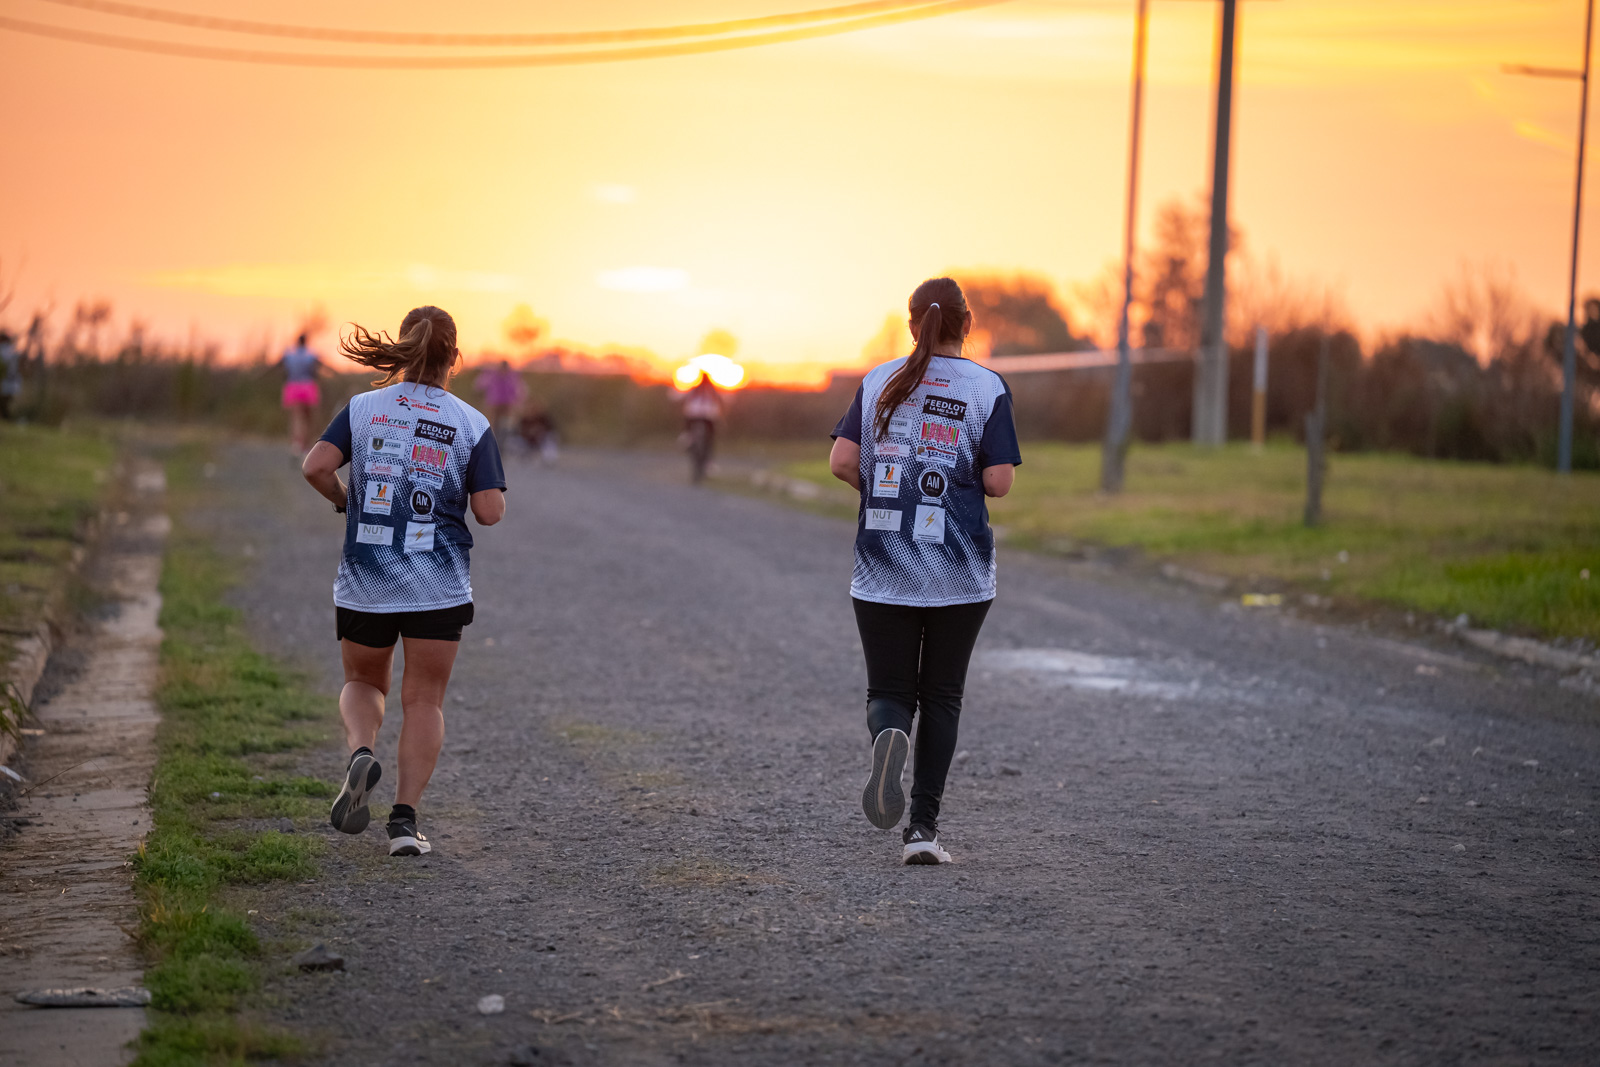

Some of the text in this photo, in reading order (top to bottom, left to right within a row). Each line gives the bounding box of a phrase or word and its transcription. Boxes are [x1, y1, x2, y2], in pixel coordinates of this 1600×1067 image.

[924, 398, 966, 413] FEEDLOT
[416, 422, 455, 438] FEEDLOT
[872, 509, 893, 520] NUT
[363, 525, 385, 535] NUT
